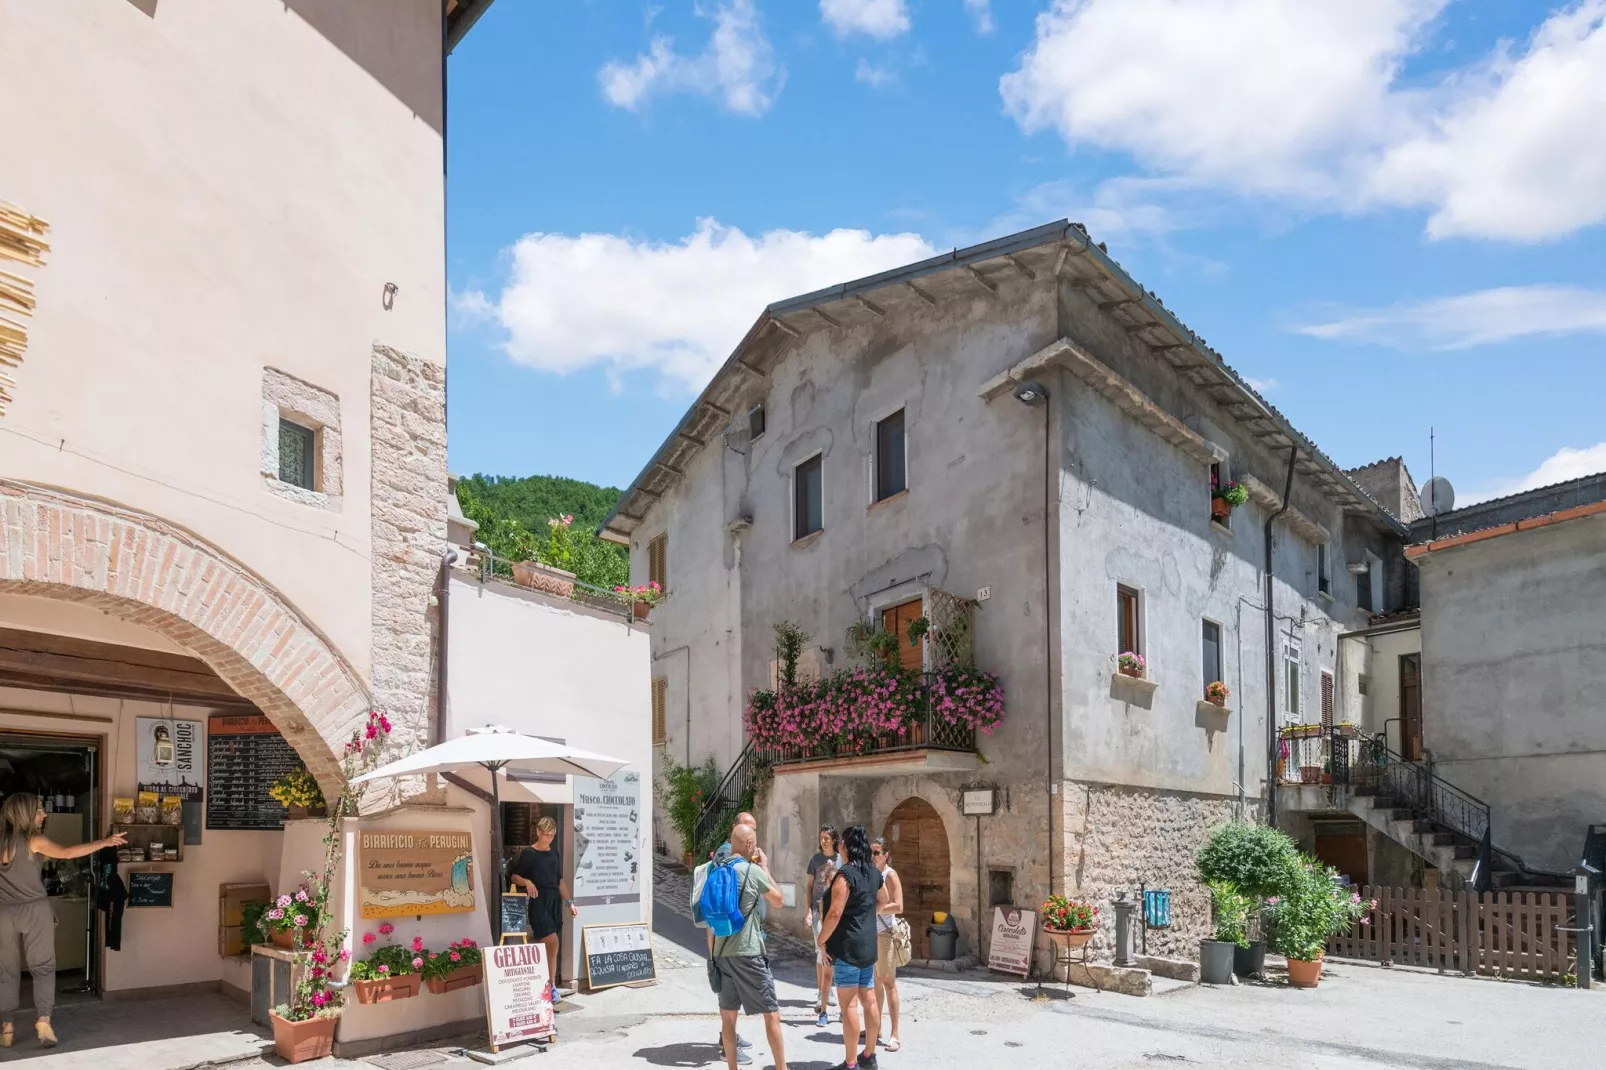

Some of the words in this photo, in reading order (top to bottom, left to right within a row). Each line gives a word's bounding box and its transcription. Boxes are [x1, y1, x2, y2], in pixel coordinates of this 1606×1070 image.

[980, 589, 988, 598] 13
[177, 723, 193, 770] SANCHOC
[579, 793, 601, 805] Museo
[602, 795, 636, 806] CIOCCOLATO
[363, 834, 414, 850] BIRRIFICIO
[430, 834, 469, 849] PERUGINI
[368, 860, 381, 869] Da
[396, 860, 414, 868] buona
[408, 871, 425, 879] buona
[997, 923, 1027, 936] Cioccolato
[493, 944, 541, 968] GELATO
[590, 955, 602, 966] FA
[604, 954, 613, 964] LA
[613, 952, 628, 963] COSA
[498, 976, 522, 985] CIOCCOLATO
[504, 1002, 528, 1010] CARAMELLO
[528, 999, 542, 1007] SALATO
[511, 1006, 537, 1014] MELOGRANO
